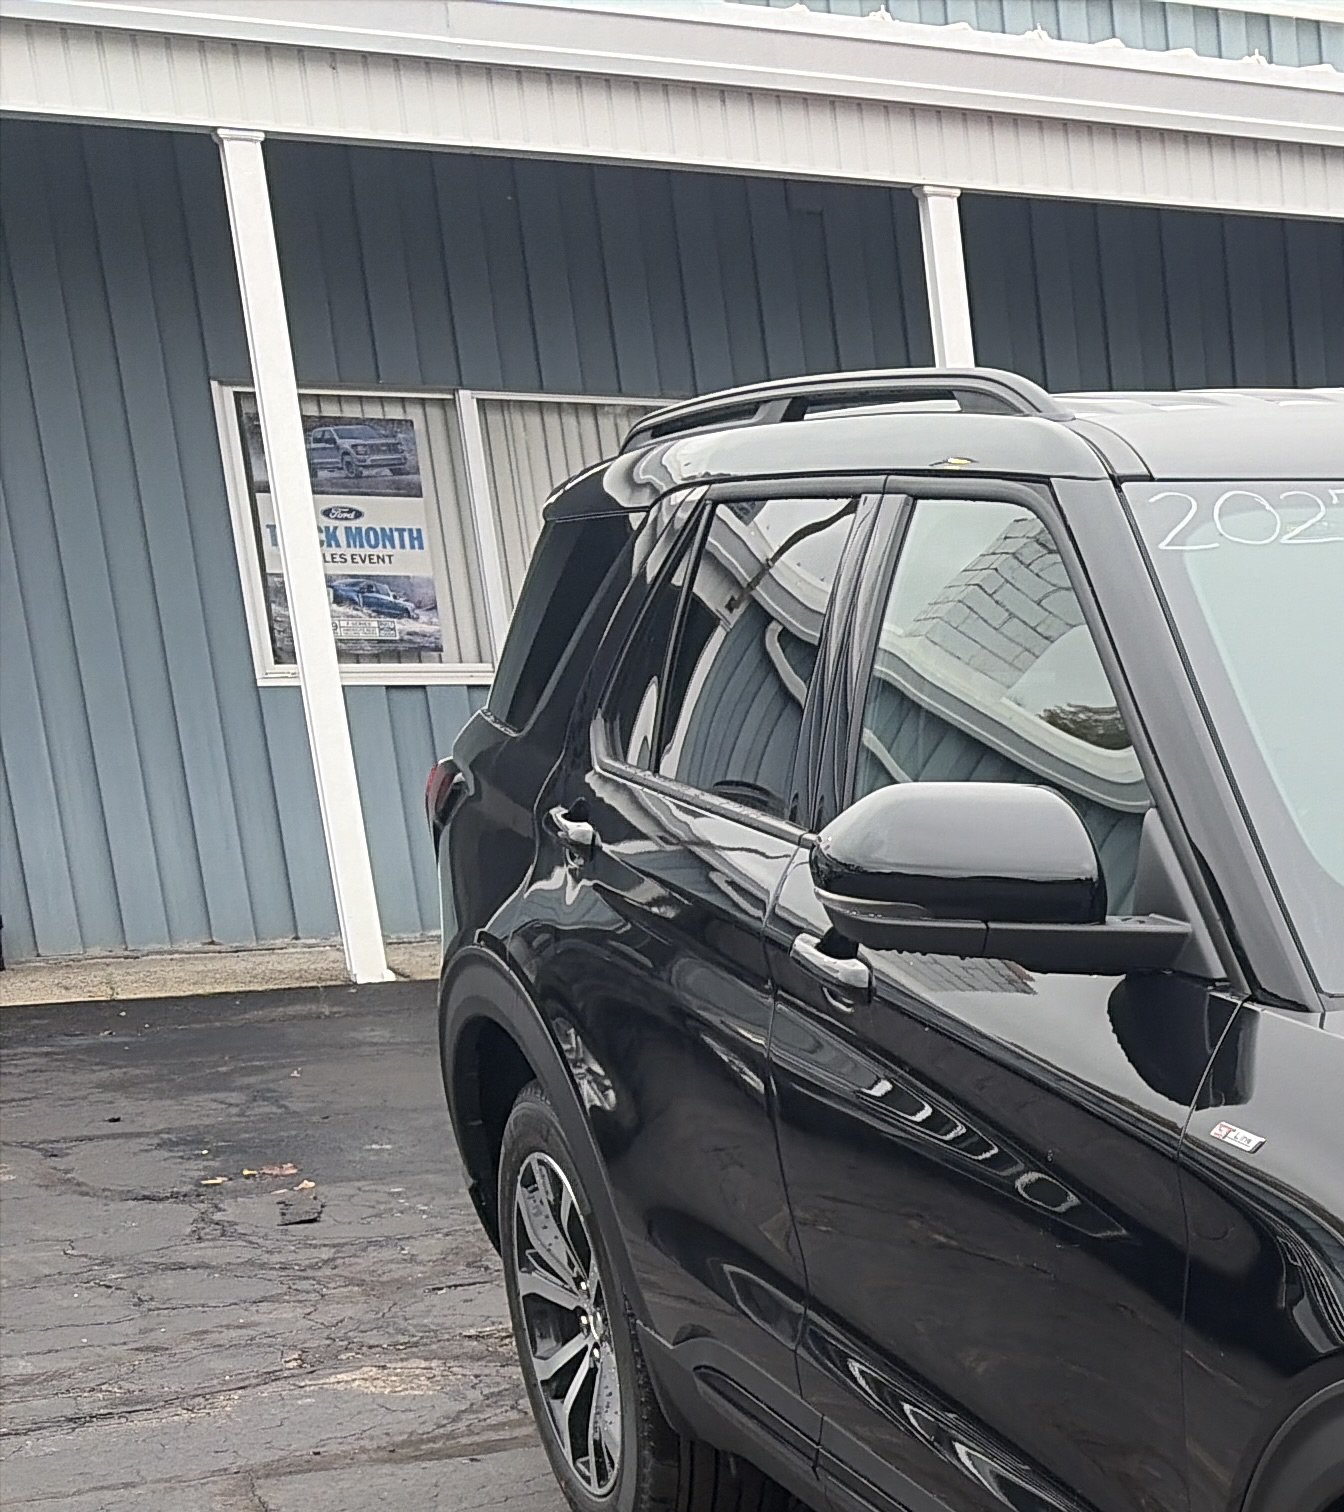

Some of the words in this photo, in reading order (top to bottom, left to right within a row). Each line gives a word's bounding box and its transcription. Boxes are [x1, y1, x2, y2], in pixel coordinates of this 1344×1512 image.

[329, 507, 355, 519] Ford
[345, 526, 424, 550] MONTH
[323, 553, 347, 564] LES
[351, 553, 394, 565] EVENT
